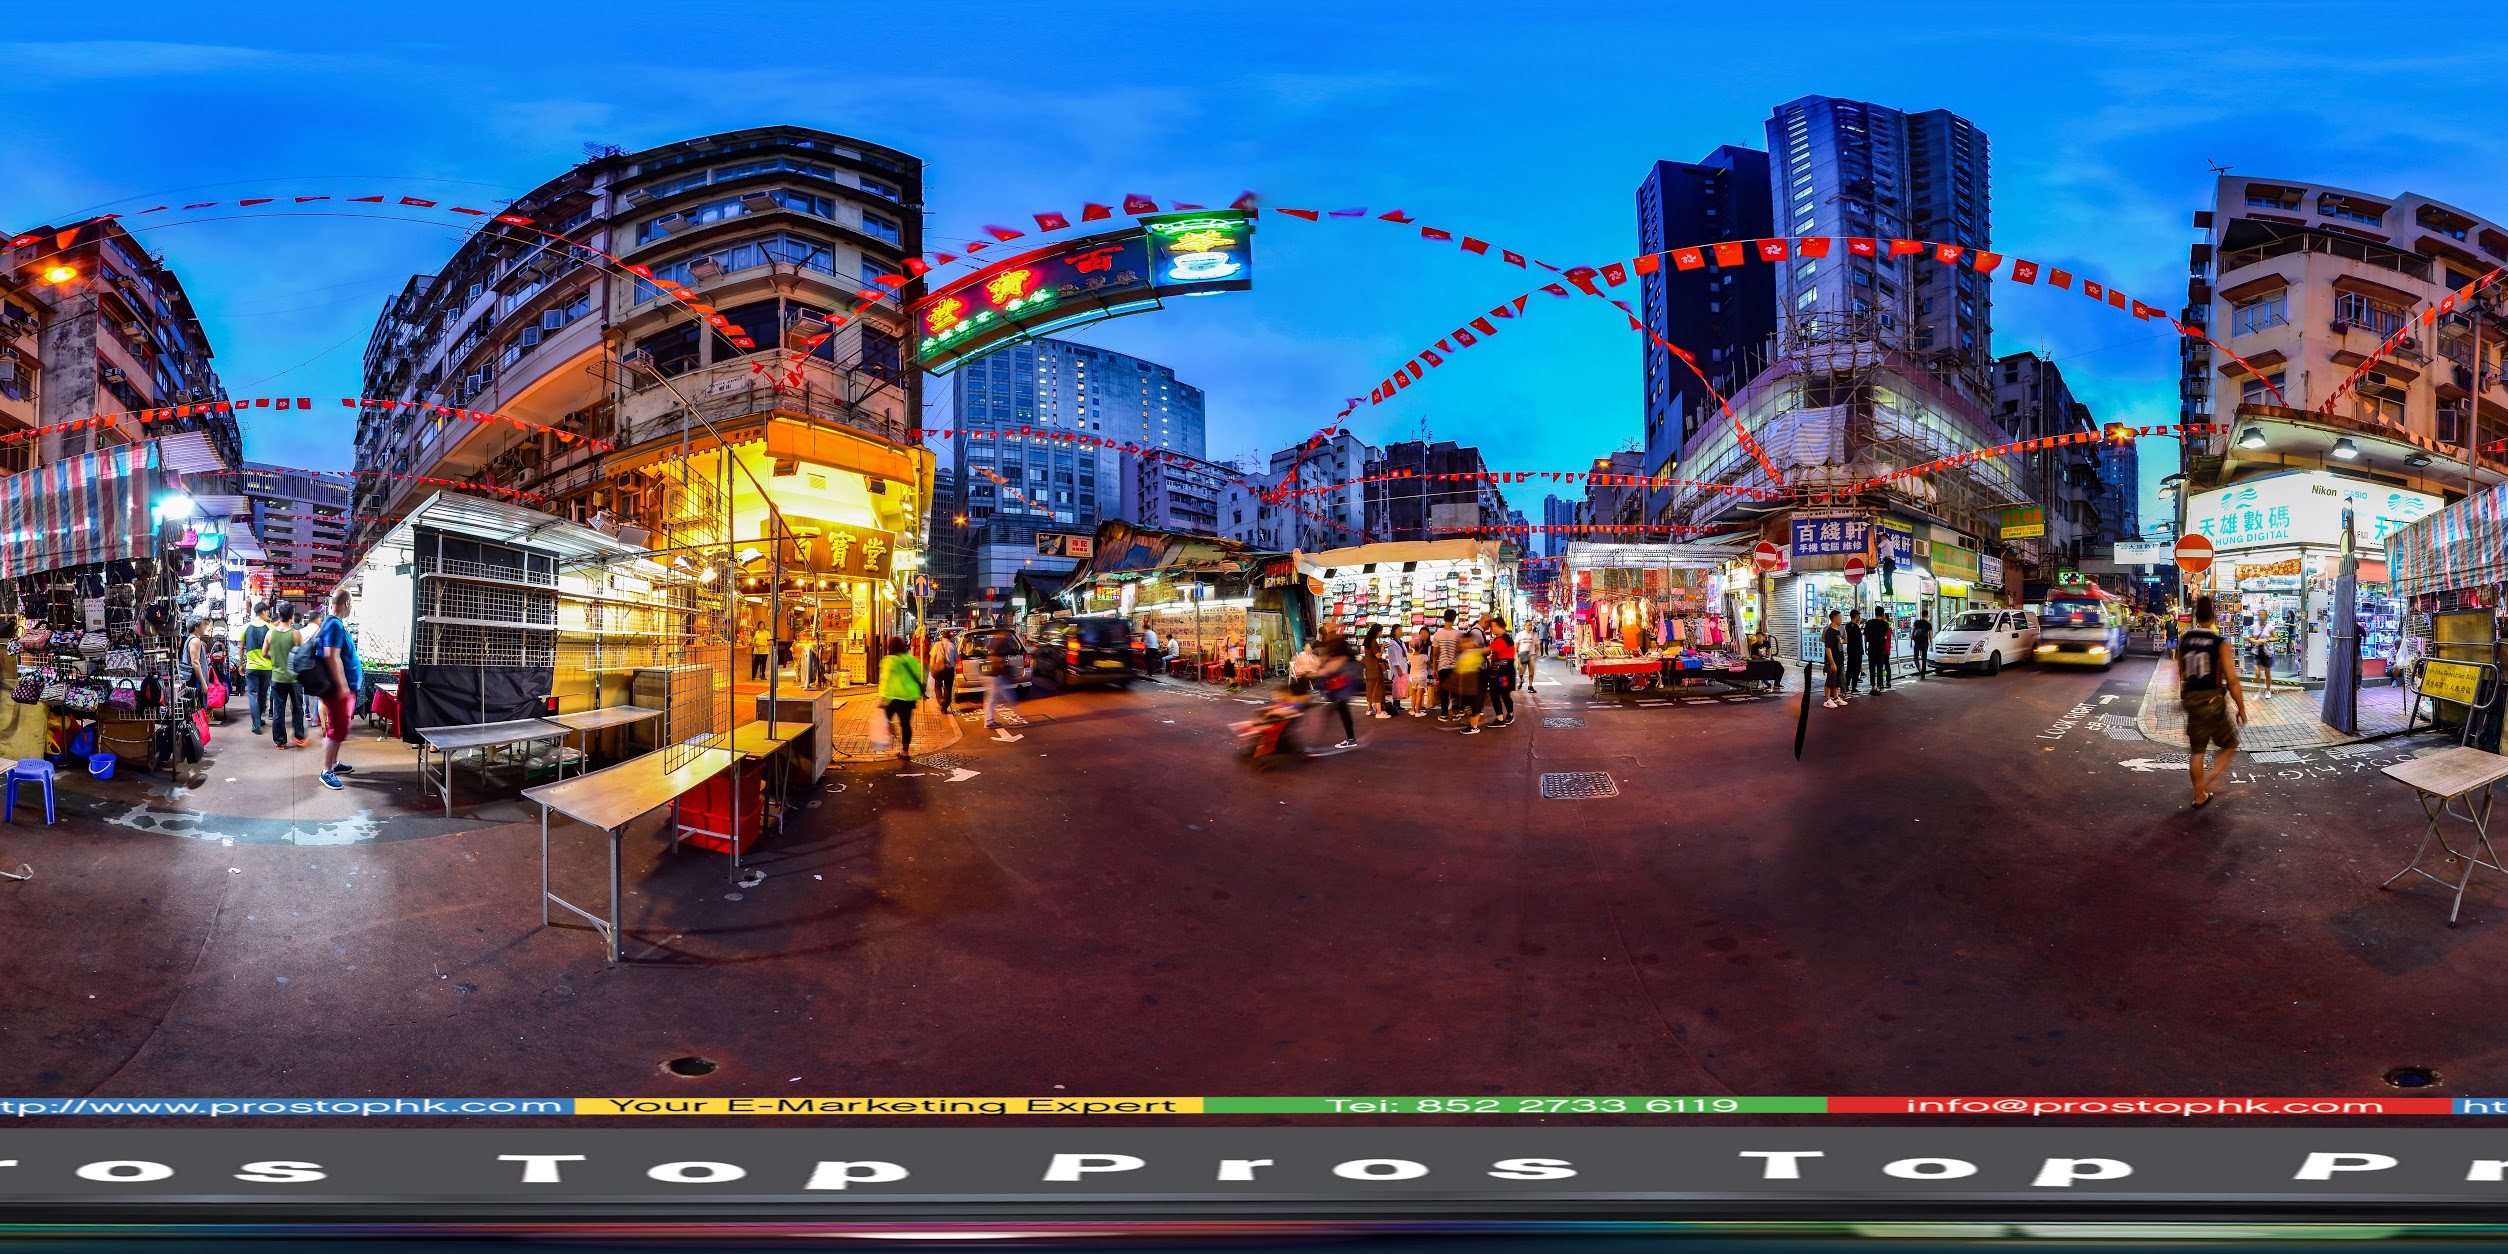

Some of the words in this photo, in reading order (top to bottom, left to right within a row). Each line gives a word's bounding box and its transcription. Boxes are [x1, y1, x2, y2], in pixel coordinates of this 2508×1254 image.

[2312, 485, 2337, 496] Nikon
[2344, 489, 2368, 499] CASIO
[2199, 505, 2290, 537] 天雄數碼
[789, 526, 887, 572] 百寶堂
[1799, 543, 1818, 553] 手機
[1820, 542, 1840, 552] 電腦
[1843, 541, 1863, 550] 維修
[2216, 535, 2244, 546] HUNG
[2247, 529, 2289, 542] DIGITAL
[2036, 718, 2079, 740] LOOK
[2063, 702, 2098, 720] RIGHT
